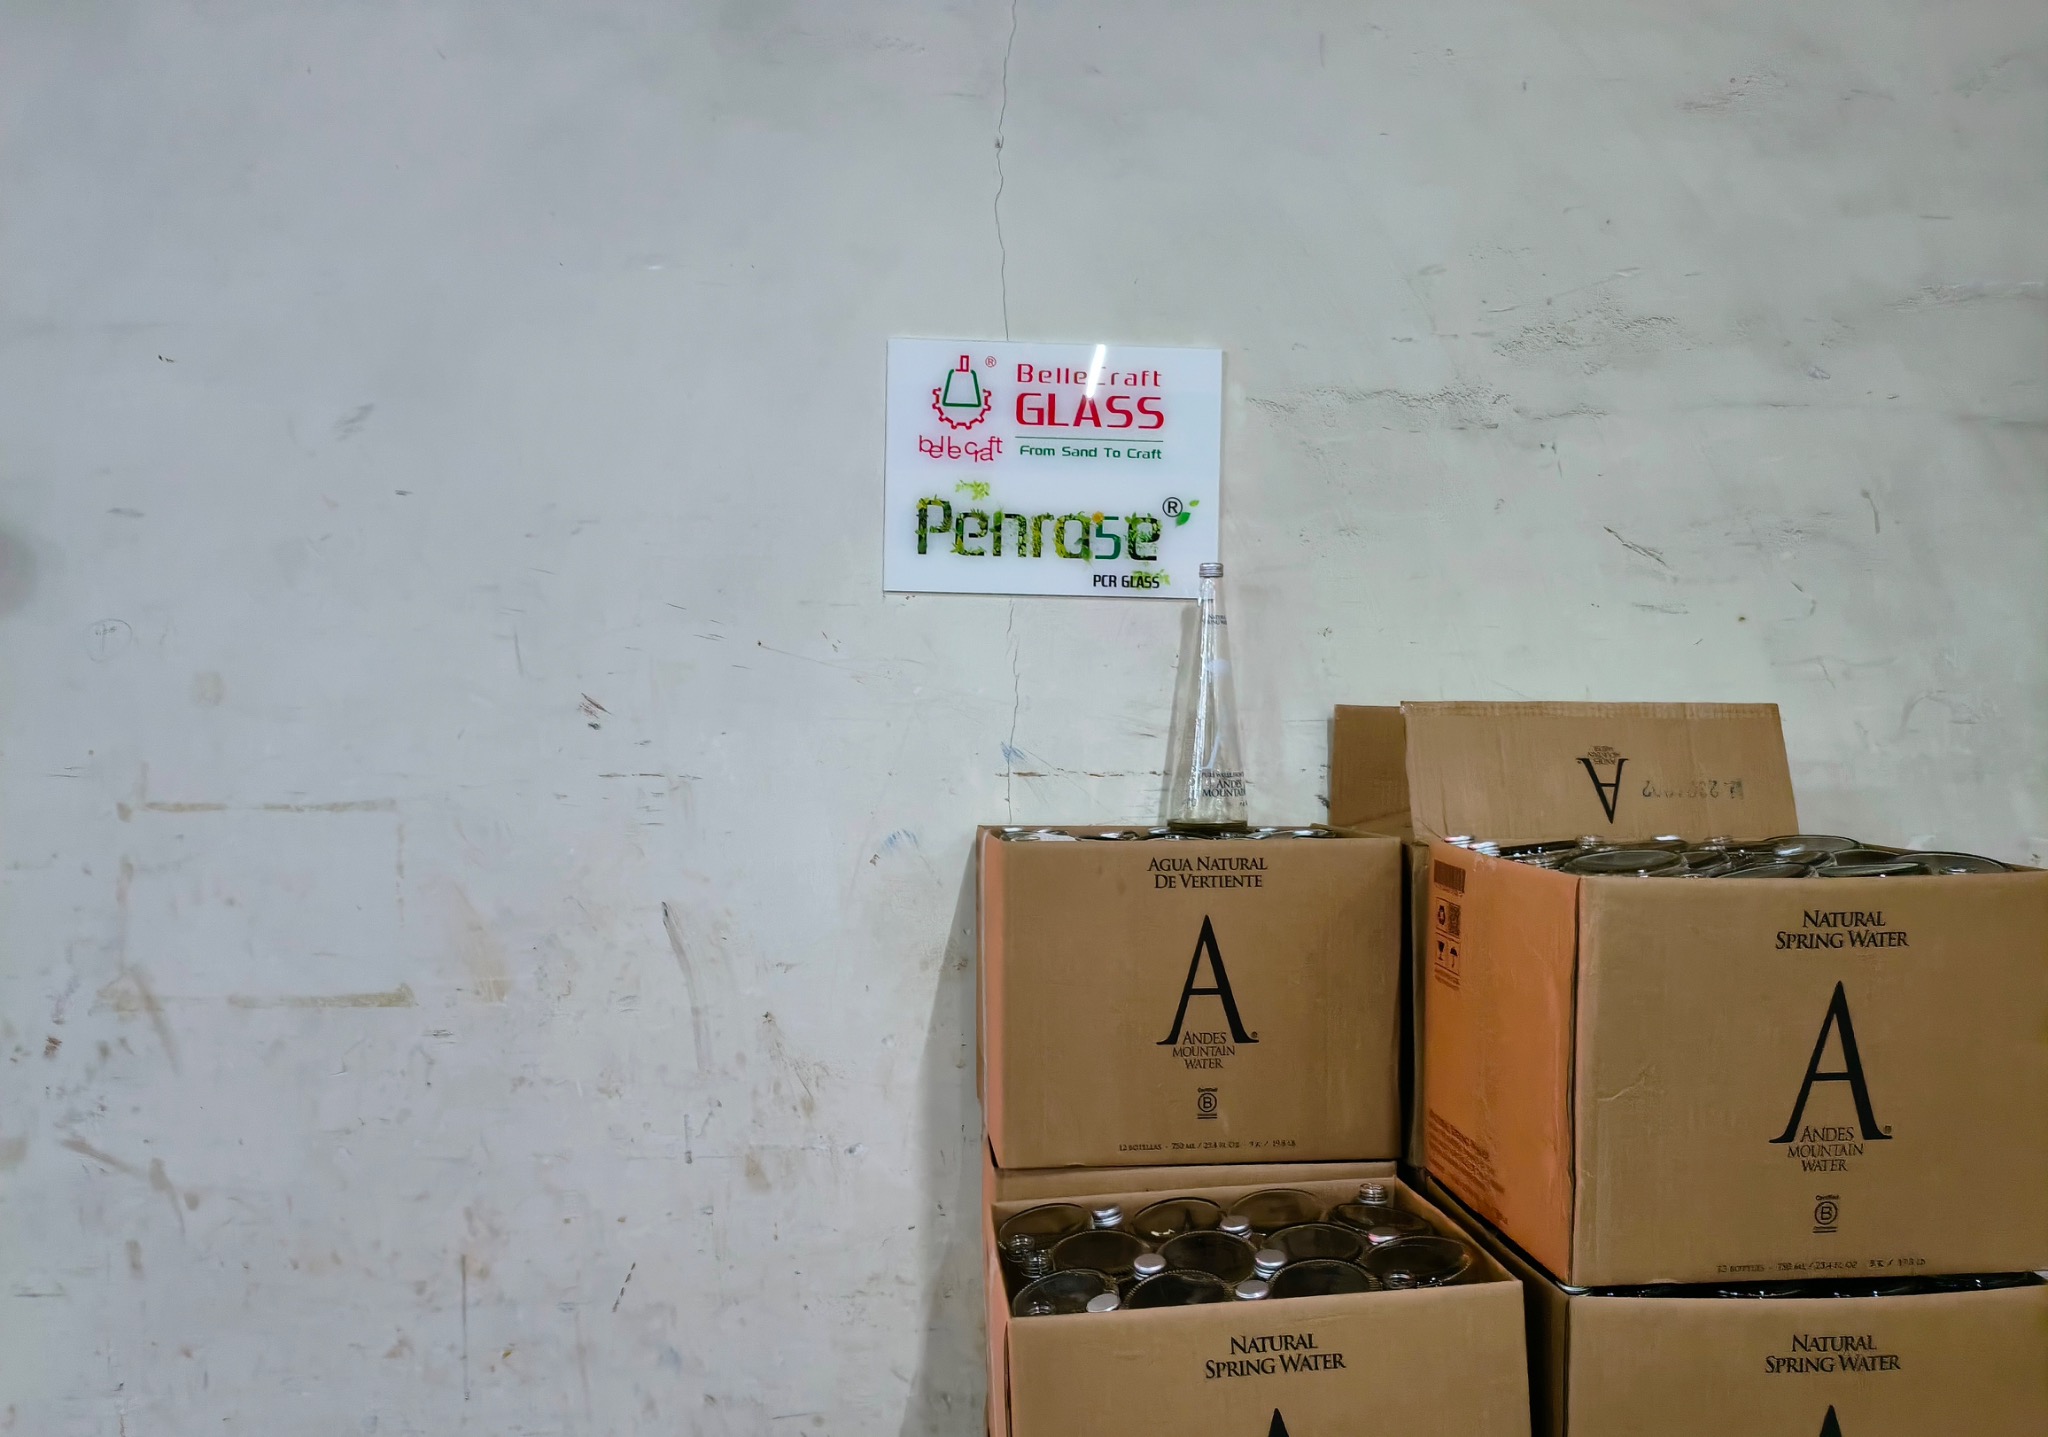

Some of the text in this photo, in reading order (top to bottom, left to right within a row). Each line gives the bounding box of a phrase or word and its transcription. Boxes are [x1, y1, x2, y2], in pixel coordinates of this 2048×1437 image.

[1015, 392, 1165, 429] GLASS
[1020, 445, 1162, 459] From Sand To Craft
[1093, 574, 1160, 589] PCR GLASS
[1147, 856, 1268, 871] AGUA NATURAL
[1154, 874, 1263, 888] DE VERTIENTE
[1802, 910, 1886, 928] NATURAL
[1775, 930, 1910, 950] SPRING WATER
[1156, 914, 1259, 1045] A
[1182, 1031, 1227, 1045] ANDES
[1172, 1046, 1235, 1058] MOUNTAIN
[1184, 1059, 1224, 1070] WATER
[1769, 980, 1893, 1144] A
[1800, 1126, 1854, 1142] ANDES
[1787, 1143, 1864, 1158] MOUNTAIN
[1801, 1159, 1848, 1172] WATER
[1230, 1333, 1318, 1354] NATURAL
[1792, 1334, 1877, 1352] NATURAL
[1205, 1353, 1346, 1378] SPRING WATER
[1766, 1354, 1901, 1373] SPRING WATER
